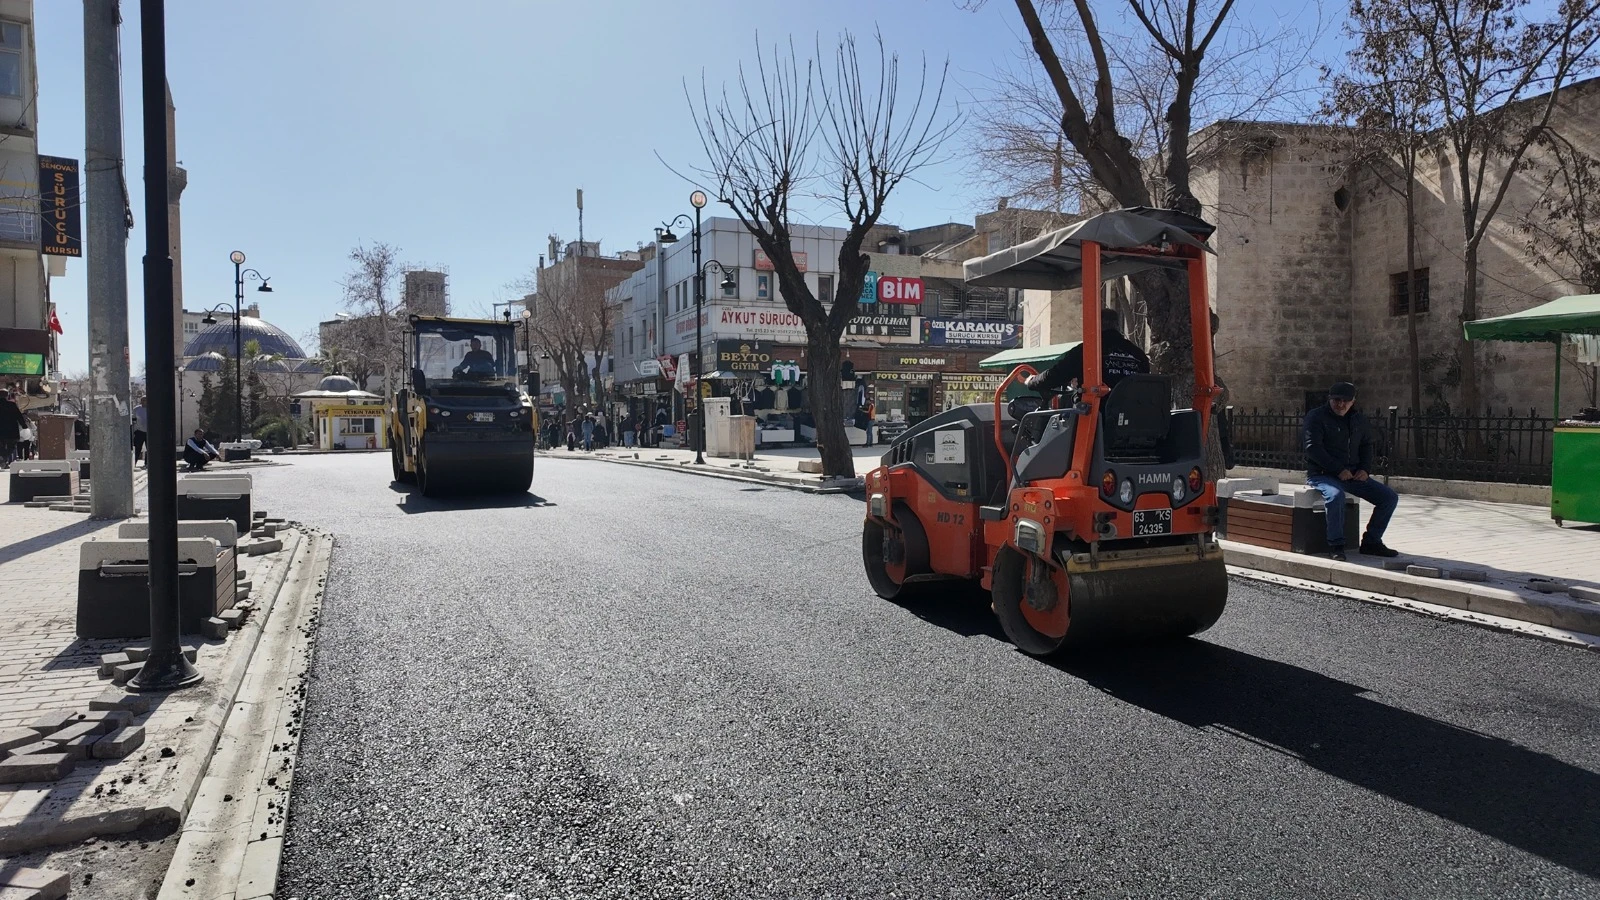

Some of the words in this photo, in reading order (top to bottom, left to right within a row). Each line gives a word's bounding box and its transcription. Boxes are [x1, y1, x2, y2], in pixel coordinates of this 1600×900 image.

[45, 246, 79, 255] KURSU
[721, 311, 756, 324] AYKUT
[848, 316, 871, 324] OTO
[873, 314, 909, 326] GÜLHAN
[931, 320, 945, 329] ÖZEL
[945, 321, 1015, 336] KARAKUŞ
[720, 352, 770, 363] BEYTO
[918, 357, 945, 365] GÜLHAN
[900, 372, 933, 380] GÜLHAN
[1138, 473, 1171, 484] HAMM
[937, 511, 950, 523] HD
[953, 513, 965, 525] 12
[1134, 512, 1145, 523] 63
[1159, 510, 1171, 521] KS
[1139, 523, 1164, 535] 24335
